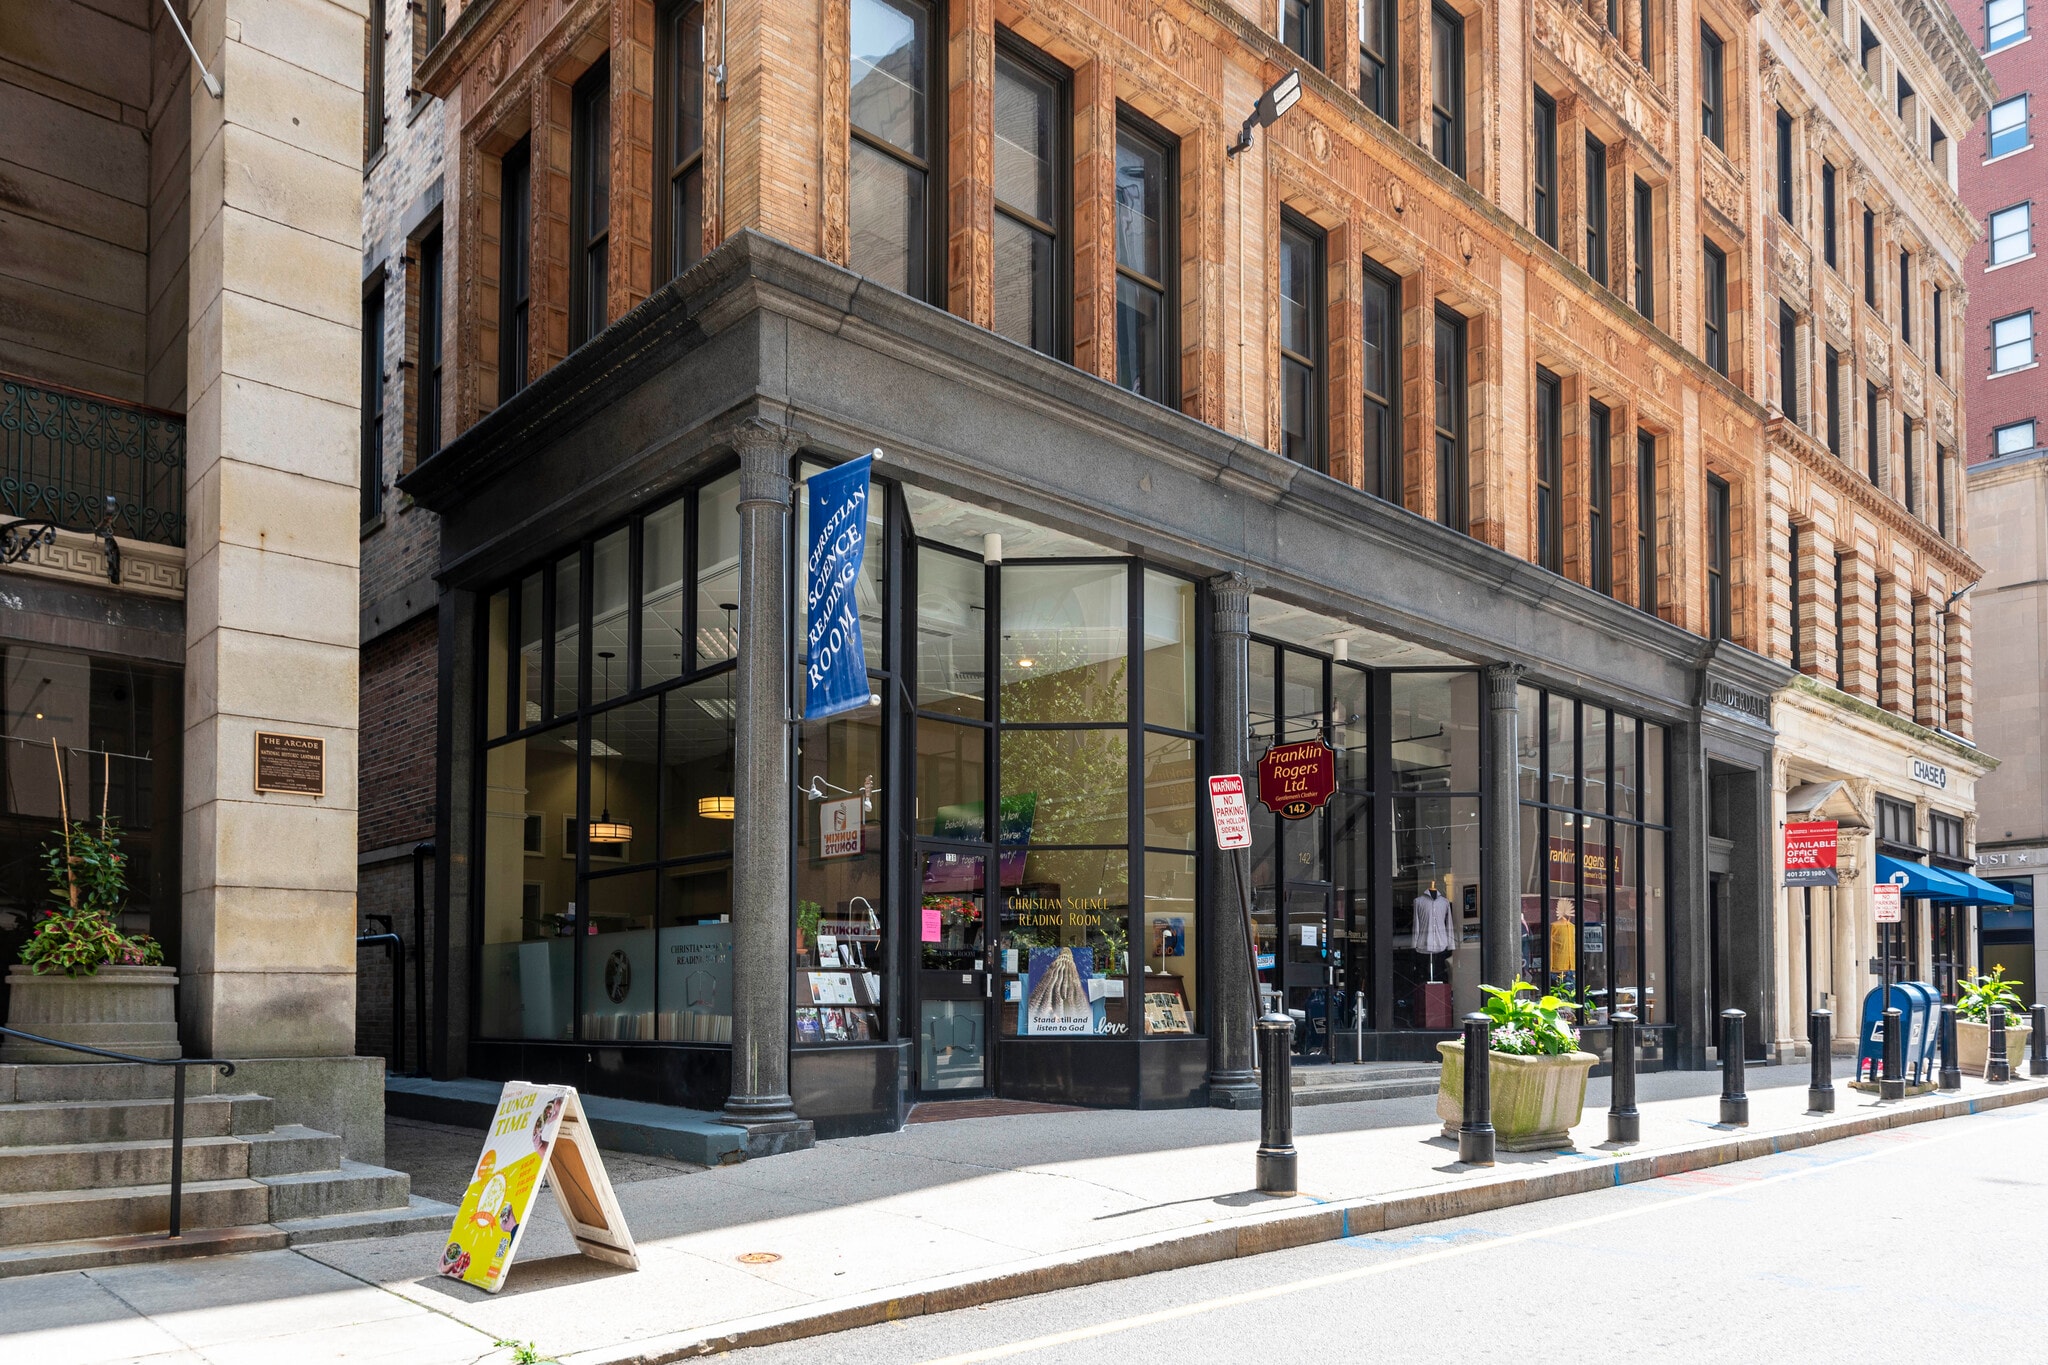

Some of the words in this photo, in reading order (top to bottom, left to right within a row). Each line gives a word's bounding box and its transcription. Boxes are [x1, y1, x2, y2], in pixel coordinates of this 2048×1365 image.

[809, 484, 866, 573] CHRISTIAN
[809, 523, 862, 611] SCIENCE
[808, 561, 855, 648] READING
[808, 602, 856, 690] ROOM
[1709, 681, 1768, 719] LAUDERDALE
[263, 737, 281, 745] THE
[284, 740, 319, 749] ARCADE
[1269, 745, 1322, 765] Franklin
[1273, 763, 1318, 780] Rogers
[1914, 760, 1939, 784] CHASE
[1211, 779, 1241, 793] WARNING
[1284, 778, 1308, 793] Ltd.
[1223, 796, 1234, 805] NO
[1275, 793, 1301, 802] Gentlemen's
[1216, 806, 1244, 817] PARKING
[1288, 803, 1306, 814] 142
[1226, 816, 1245, 825] HOLLOW
[1221, 826, 1245, 834] SIDEWALK
[1787, 840, 1837, 849] AVAILABLE
[1299, 853, 1311, 865] 142
[1549, 845, 1575, 863] ranklin
[1787, 849, 1818, 857] OFFICE
[1787, 856, 1816, 864] SPACE
[1974, 853, 2009, 866] RUST
[961, 855, 985, 868] togethe
[1584, 854, 1605, 870] ogers
[1008, 896, 1062, 910] CHRISTIAN
[1067, 896, 1109, 910] SCIENCE
[1018, 913, 1063, 926] READING
[1069, 912, 1101, 926] ROOM
[1033, 1016, 1056, 1024] Stand
[1057, 1016, 1072, 1024] still
[1073, 1016, 1088, 1024] and
[1094, 1016, 1129, 1034] love
[1036, 1023, 1058, 1032] listen
[1069, 1024, 1085, 1032] God
[499, 1092, 538, 1116] LUNCH
[495, 1111, 532, 1136] TIME
